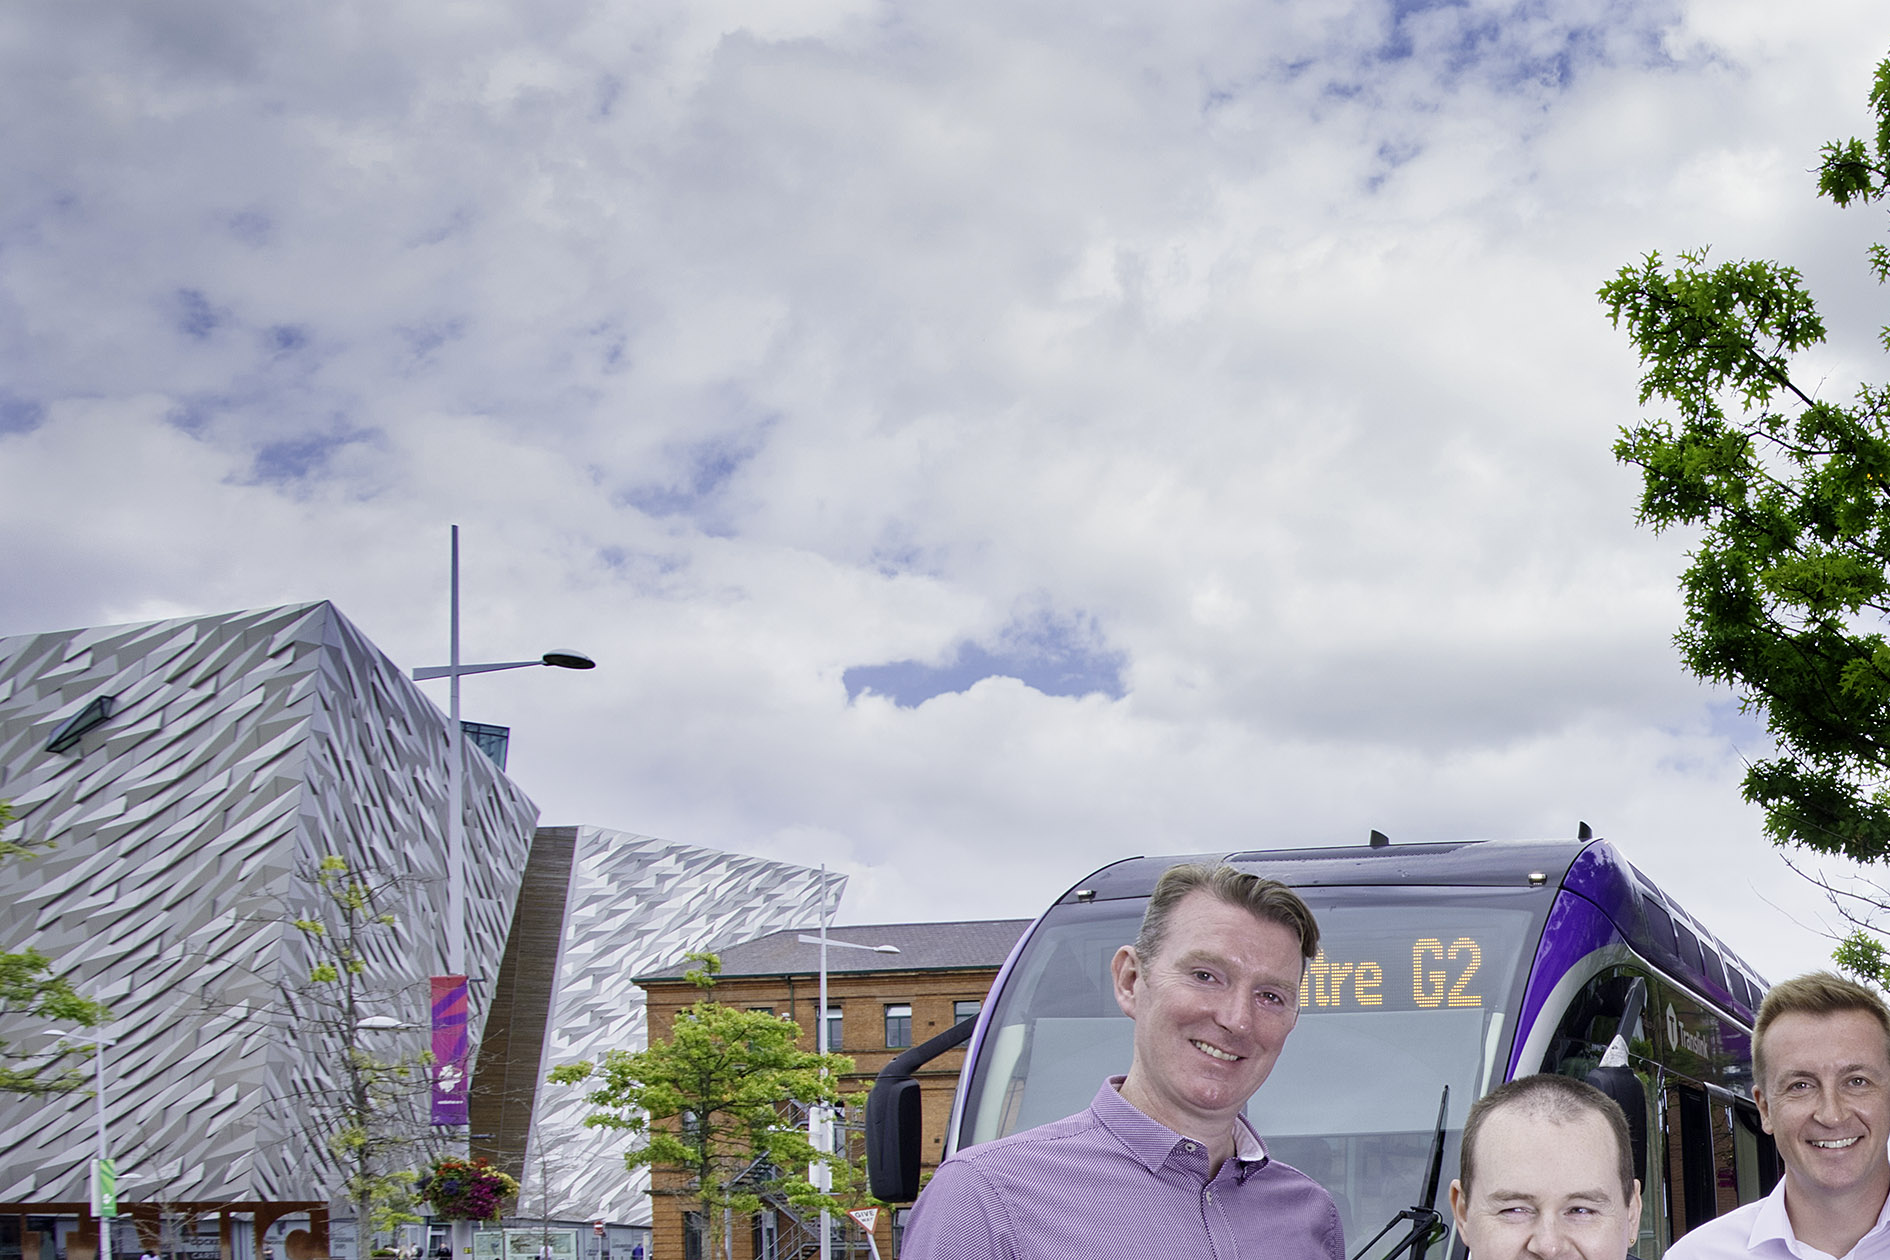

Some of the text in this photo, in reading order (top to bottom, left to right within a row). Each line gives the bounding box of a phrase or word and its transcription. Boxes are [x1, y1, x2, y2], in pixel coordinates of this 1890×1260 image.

[1413, 937, 1482, 1007] G2
[1678, 1019, 1709, 1060] Translink
[855, 1210, 875, 1218] GIVE
